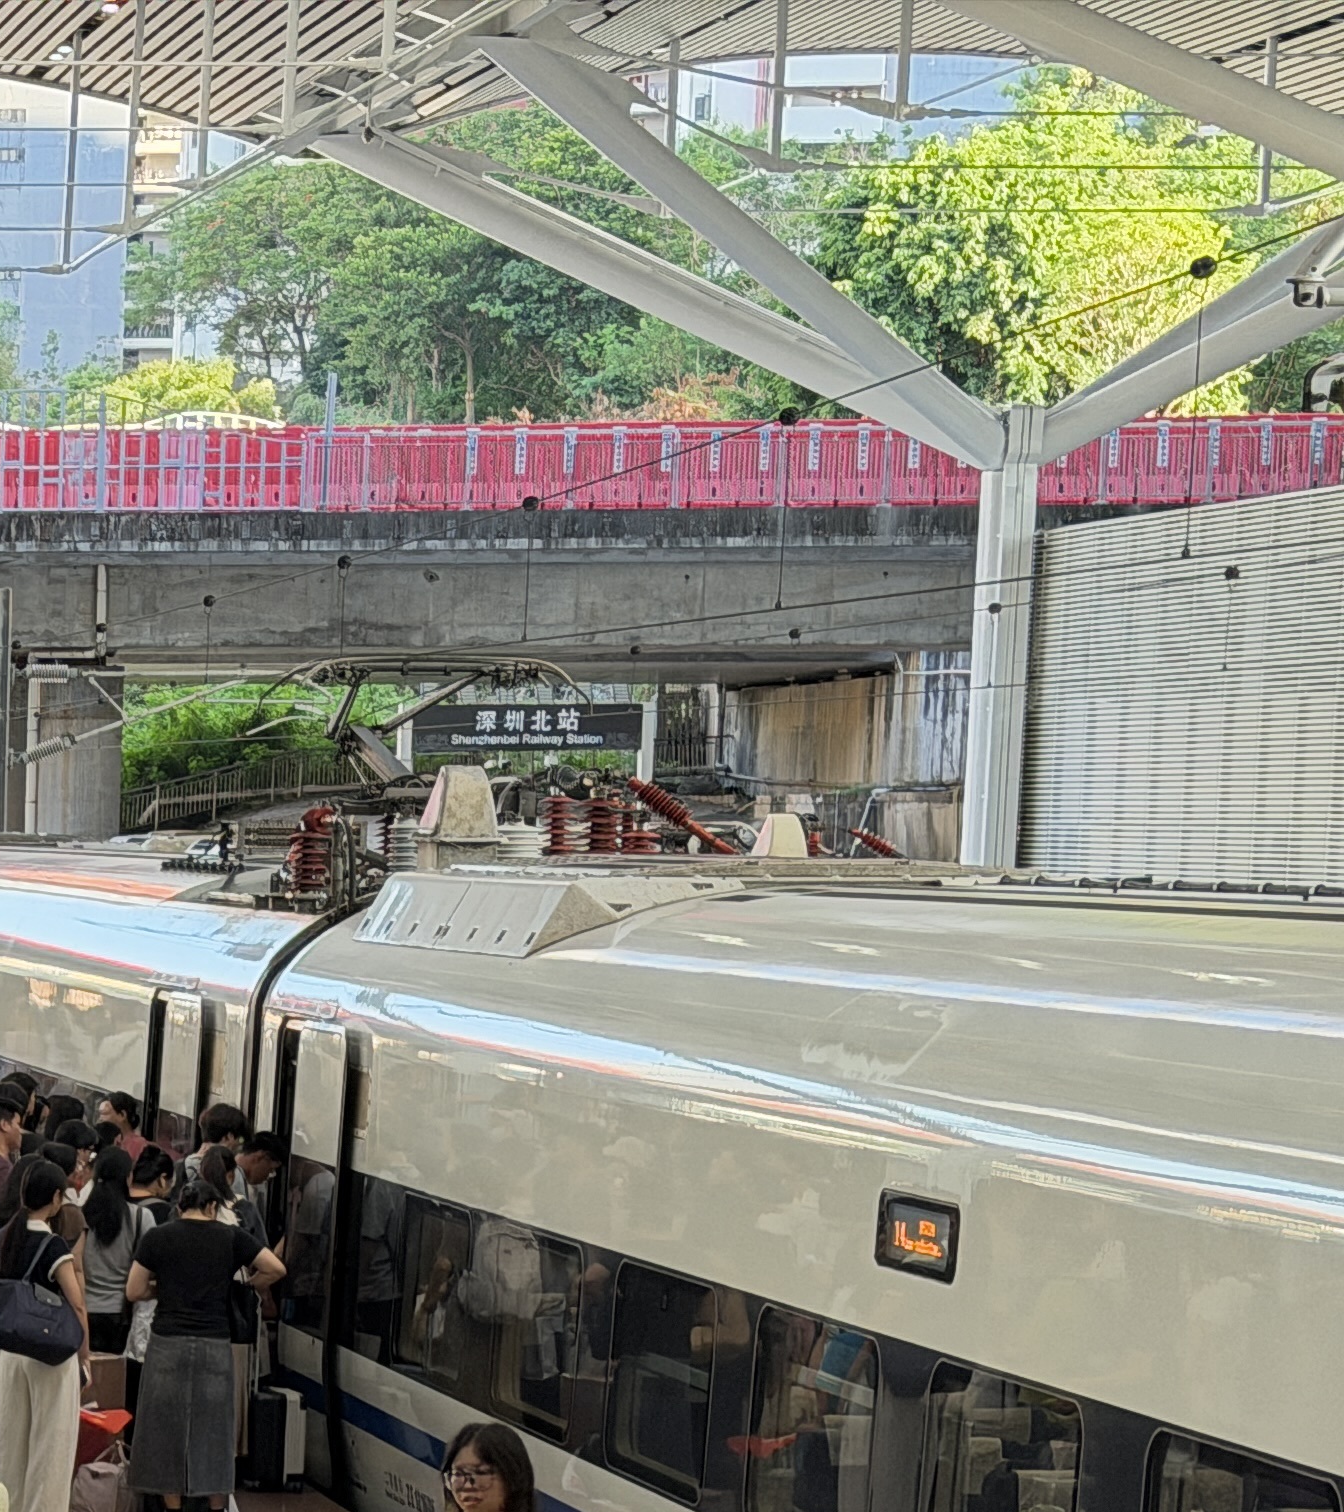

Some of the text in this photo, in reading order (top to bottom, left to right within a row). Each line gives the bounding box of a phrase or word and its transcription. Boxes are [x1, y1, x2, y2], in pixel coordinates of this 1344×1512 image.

[475, 708, 581, 732] 深圳北站
[450, 733, 603, 747] Shenzhenbei Railway Station
